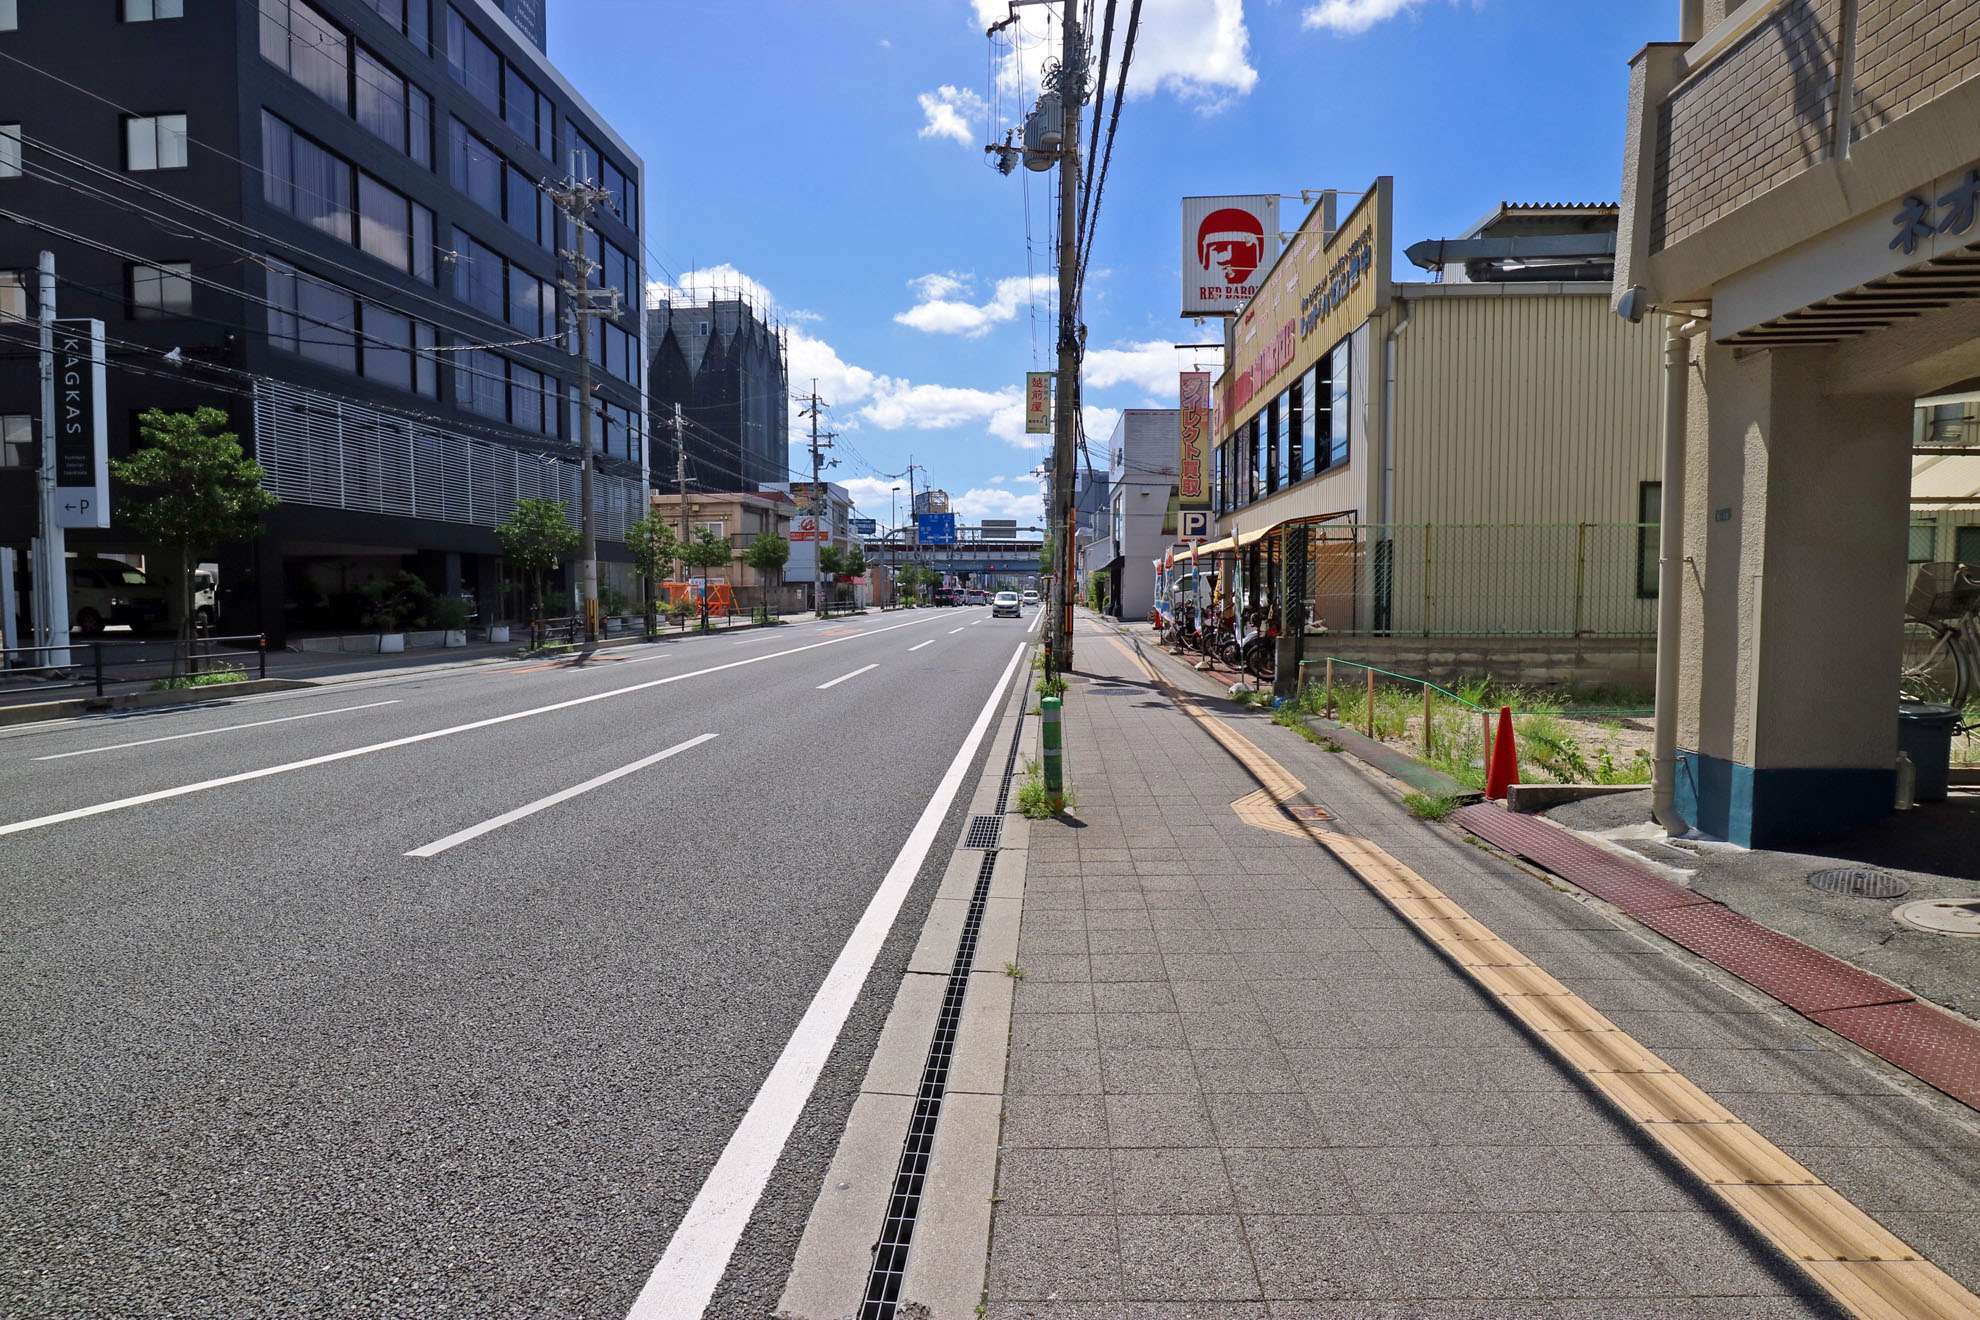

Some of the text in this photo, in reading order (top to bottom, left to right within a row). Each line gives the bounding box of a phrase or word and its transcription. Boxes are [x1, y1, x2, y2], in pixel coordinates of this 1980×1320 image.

[1225, 285, 1259, 300] BARO
[64, 339, 81, 434] KAGKAS
[80, 499, 89, 514] P
[1186, 513, 1205, 534] P
